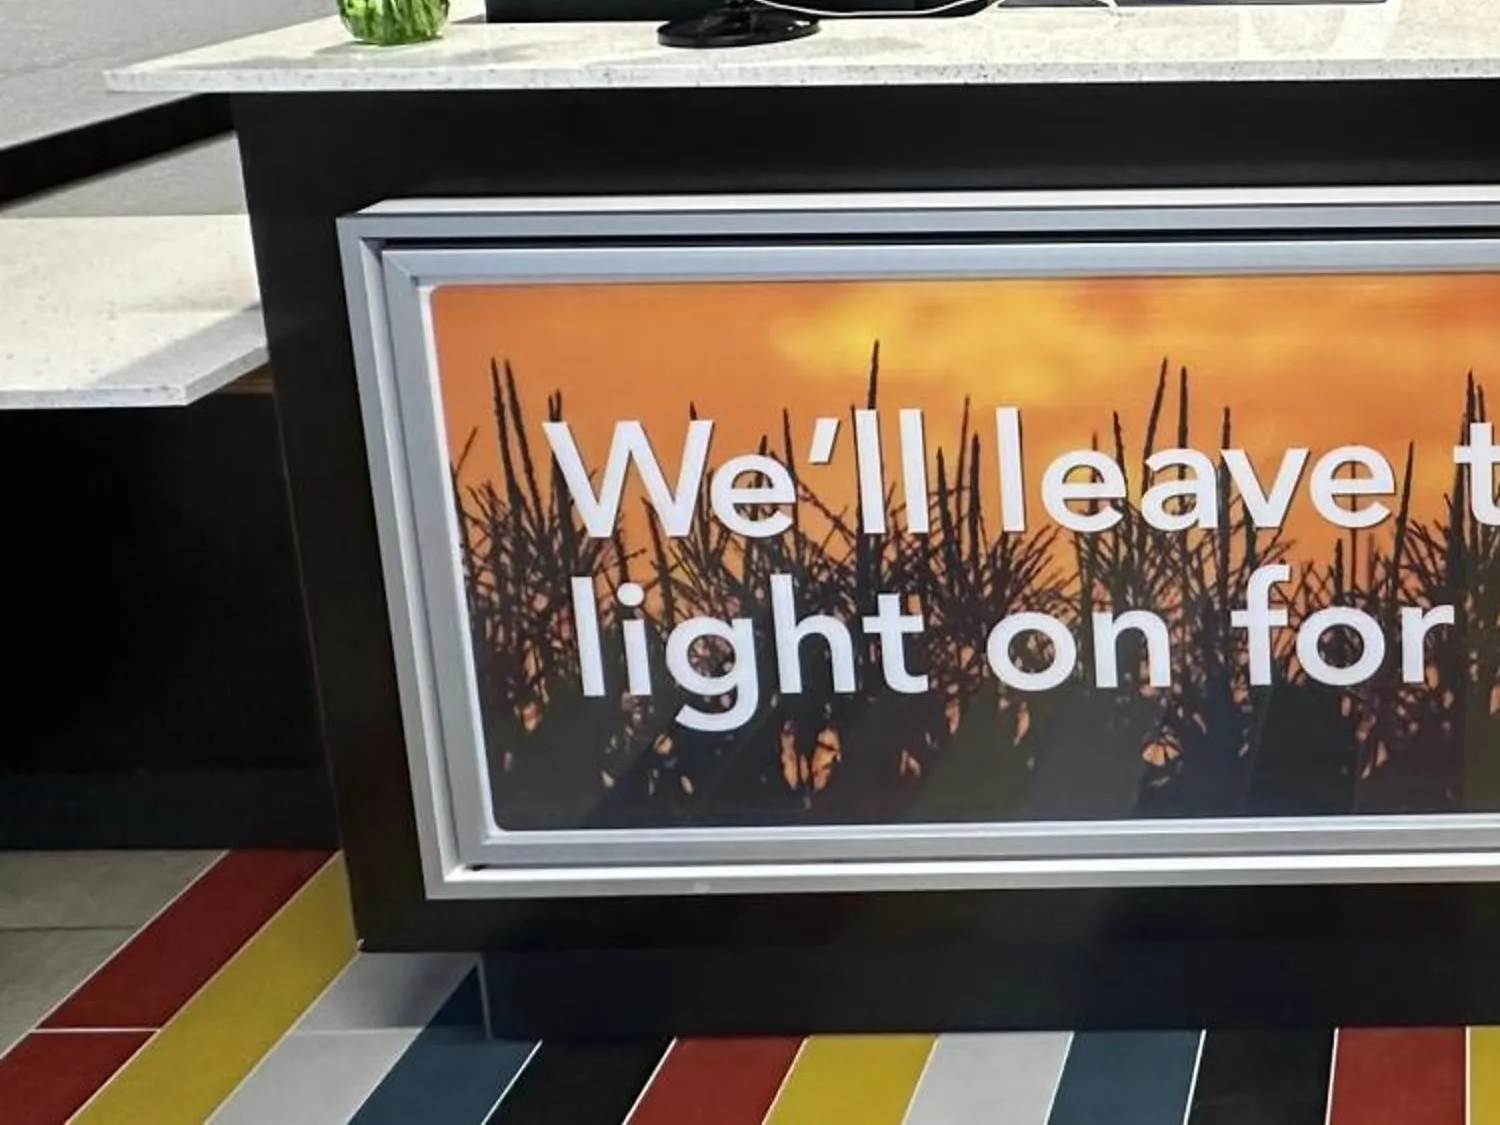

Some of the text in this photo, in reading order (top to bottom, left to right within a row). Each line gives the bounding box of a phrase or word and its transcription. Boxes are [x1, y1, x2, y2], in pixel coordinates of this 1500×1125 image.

[542, 407, 930, 538] We'll
[995, 405, 1396, 533] leave
[571, 572, 930, 733] light
[986, 605, 1172, 692] on
[1230, 563, 1456, 687] for
